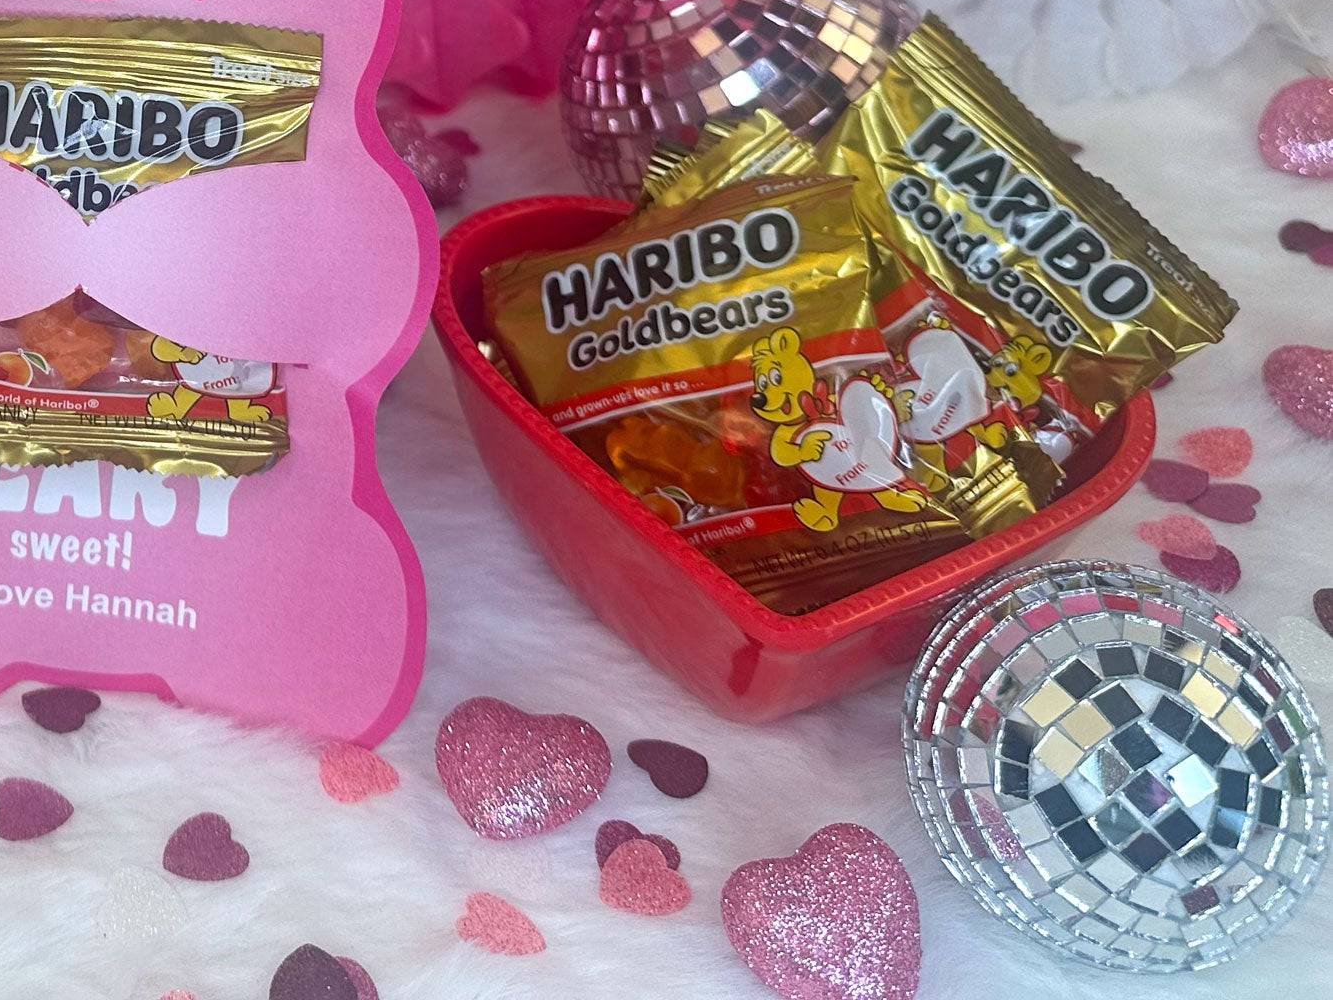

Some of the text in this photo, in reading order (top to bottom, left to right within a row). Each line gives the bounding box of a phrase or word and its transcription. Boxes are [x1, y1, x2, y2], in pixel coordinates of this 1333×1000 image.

[904, 106, 1153, 321] HARIBO
[541, 207, 799, 334] HARIBO
[888, 176, 1082, 347] Goldbears
[567, 286, 795, 371] Goldbears
[25, 396, 37, 406] of
[203, 376, 240, 391] From:
[553, 407, 575, 423] and
[576, 389, 633, 417] grown-ups
[633, 385, 659, 398] love
[661, 381, 671, 392] it
[10, 529, 133, 571] sweet!
[687, 532, 701, 546] of
[66, 583, 198, 630] Hannah
